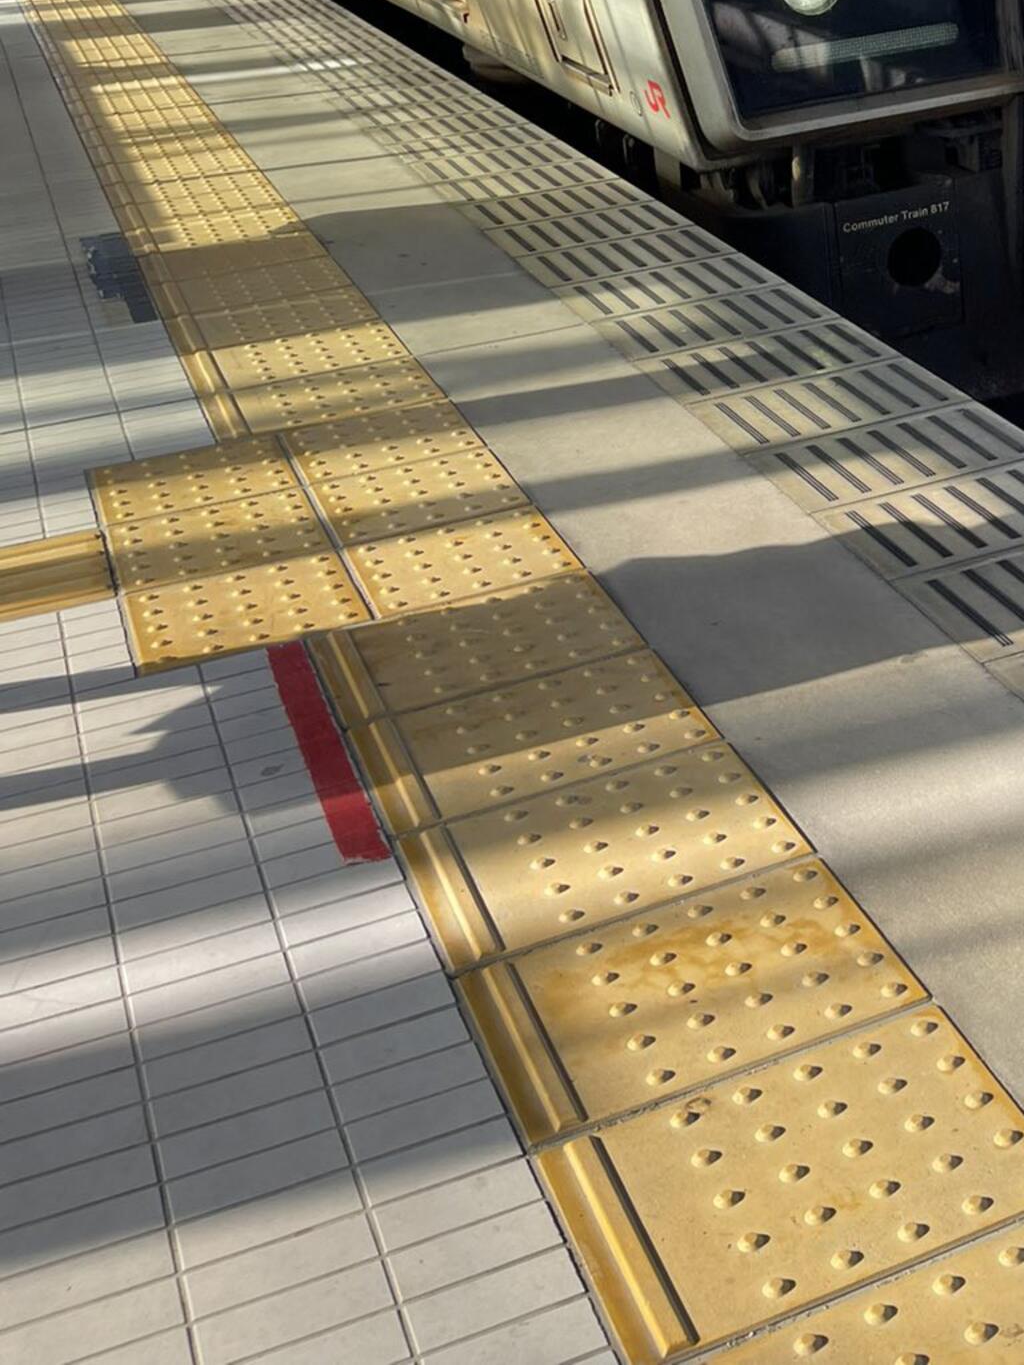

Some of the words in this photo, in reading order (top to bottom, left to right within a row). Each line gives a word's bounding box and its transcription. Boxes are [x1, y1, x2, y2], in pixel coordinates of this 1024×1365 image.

[643, 79, 671, 119] JR
[842, 213, 900, 233] Commuter
[900, 207, 929, 221] Train
[930, 201, 951, 215] 817
